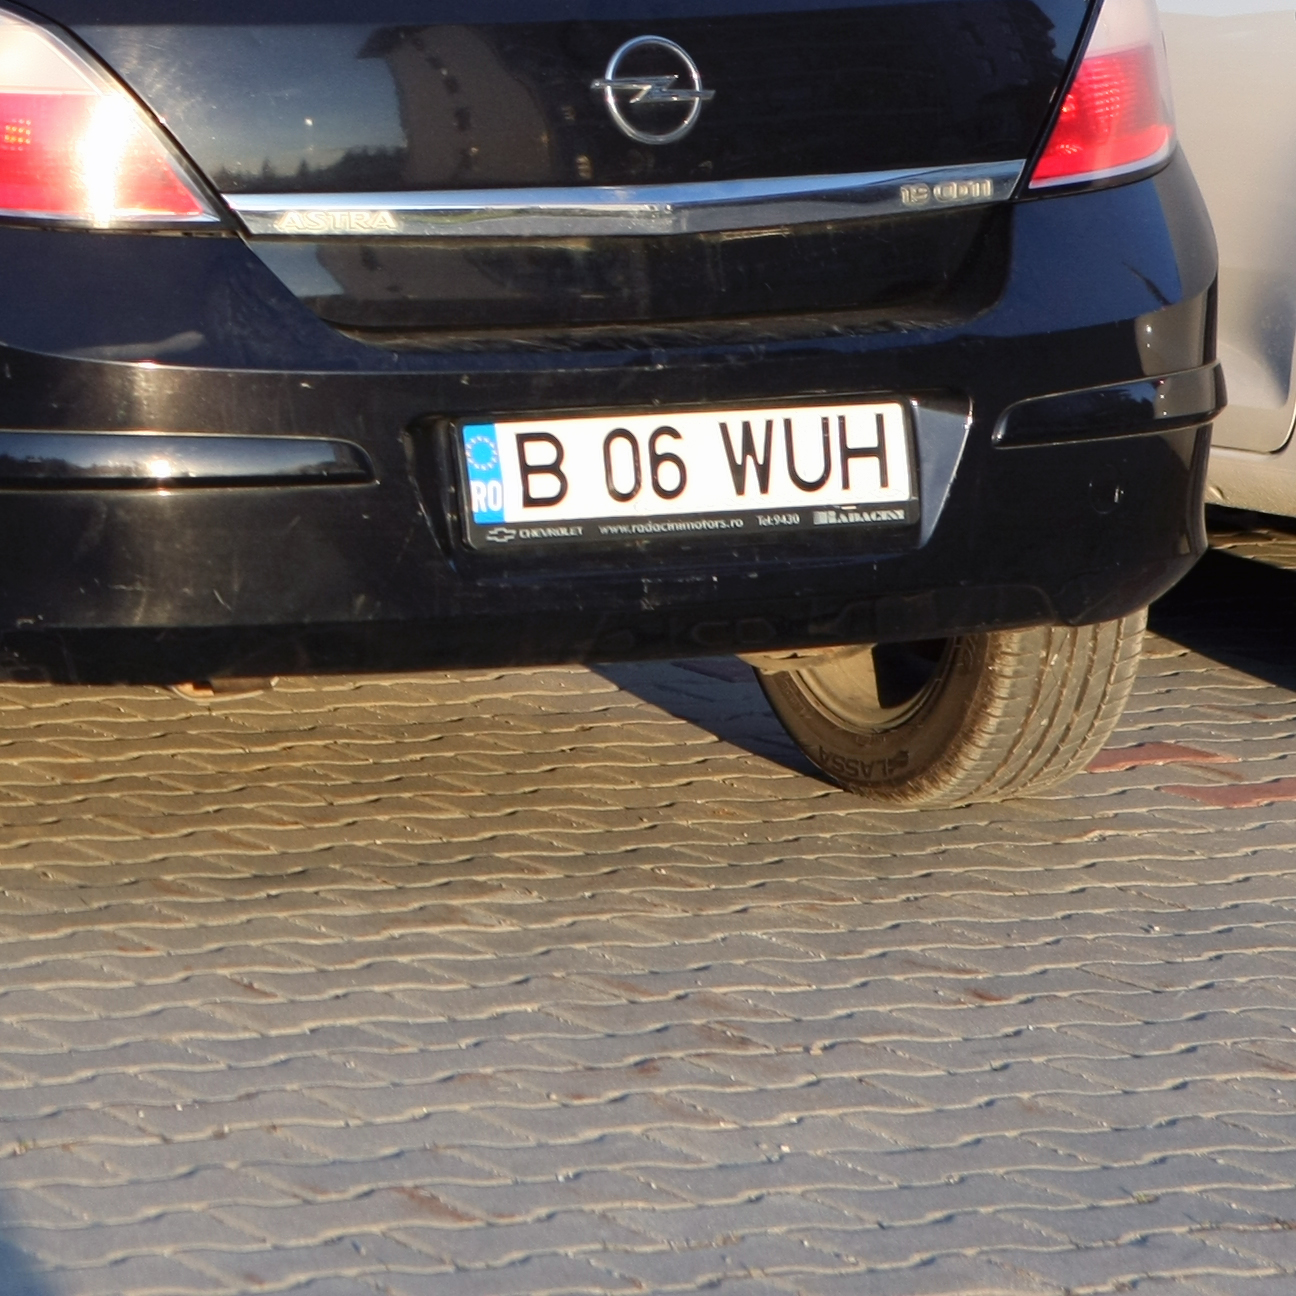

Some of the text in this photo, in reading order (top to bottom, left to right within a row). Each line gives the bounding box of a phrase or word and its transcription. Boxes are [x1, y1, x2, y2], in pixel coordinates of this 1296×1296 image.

[274, 209, 398, 232] ASTRA
[515, 412, 890, 508] B 06 WUH
[470, 479, 504, 513] RO
[518, 525, 584, 539] CHEVROLET
[598, 518, 744, 535] www.radacinimotors.ro
